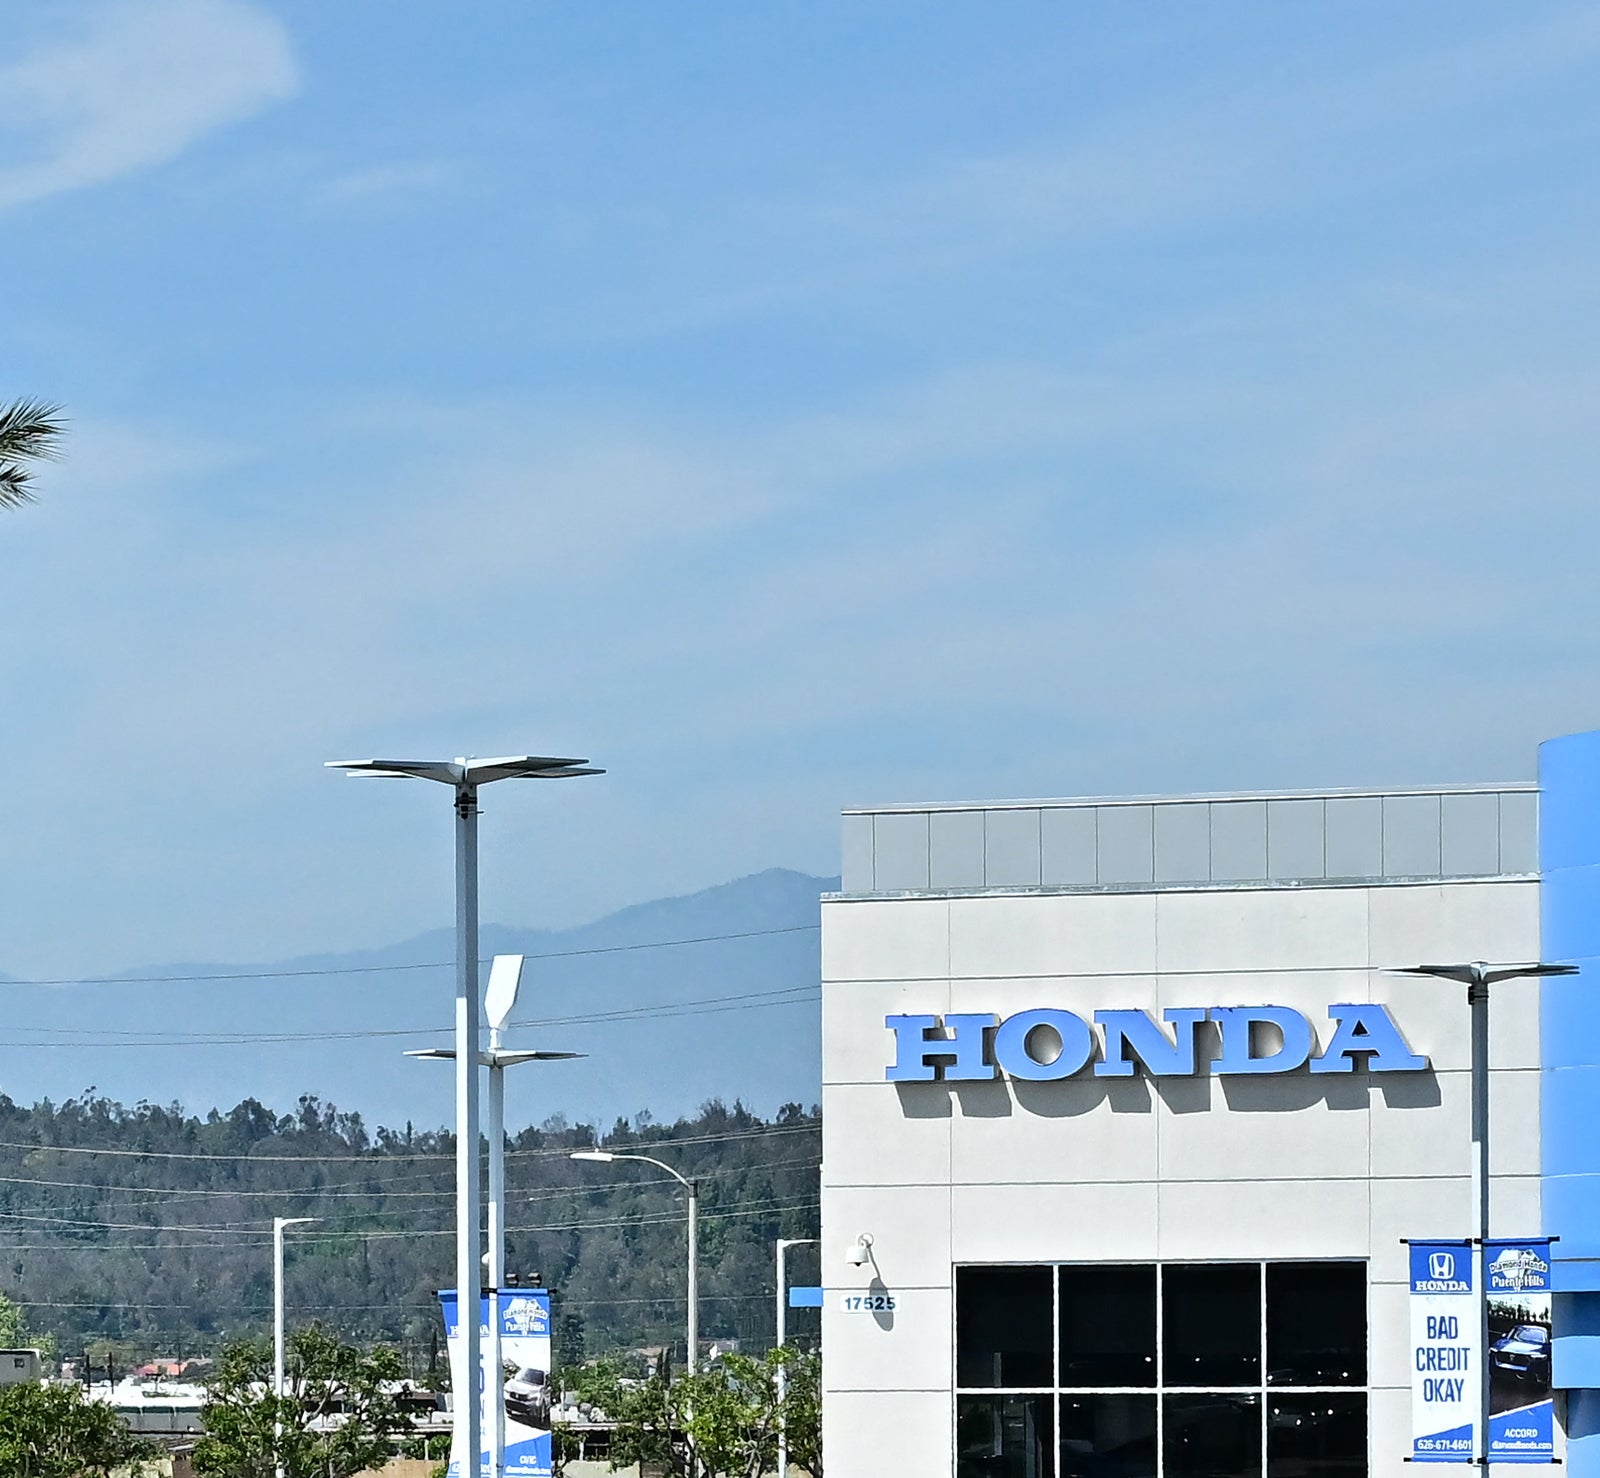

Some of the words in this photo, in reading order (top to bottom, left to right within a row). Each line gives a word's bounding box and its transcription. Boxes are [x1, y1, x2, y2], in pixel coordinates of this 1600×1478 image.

[884, 1003, 1428, 1082] HONDA
[1490, 1260, 1522, 1273] Diamond
[1415, 1280, 1469, 1291] HONDA
[1491, 1275, 1524, 1288] Puente
[1525, 1275, 1545, 1287] Hills
[844, 1296, 896, 1310] 17525
[1427, 1315, 1459, 1340] BAD
[1416, 1347, 1470, 1371] CREDIT
[1423, 1378, 1464, 1402] OKAY
[1504, 1428, 1538, 1438] ACCORD
